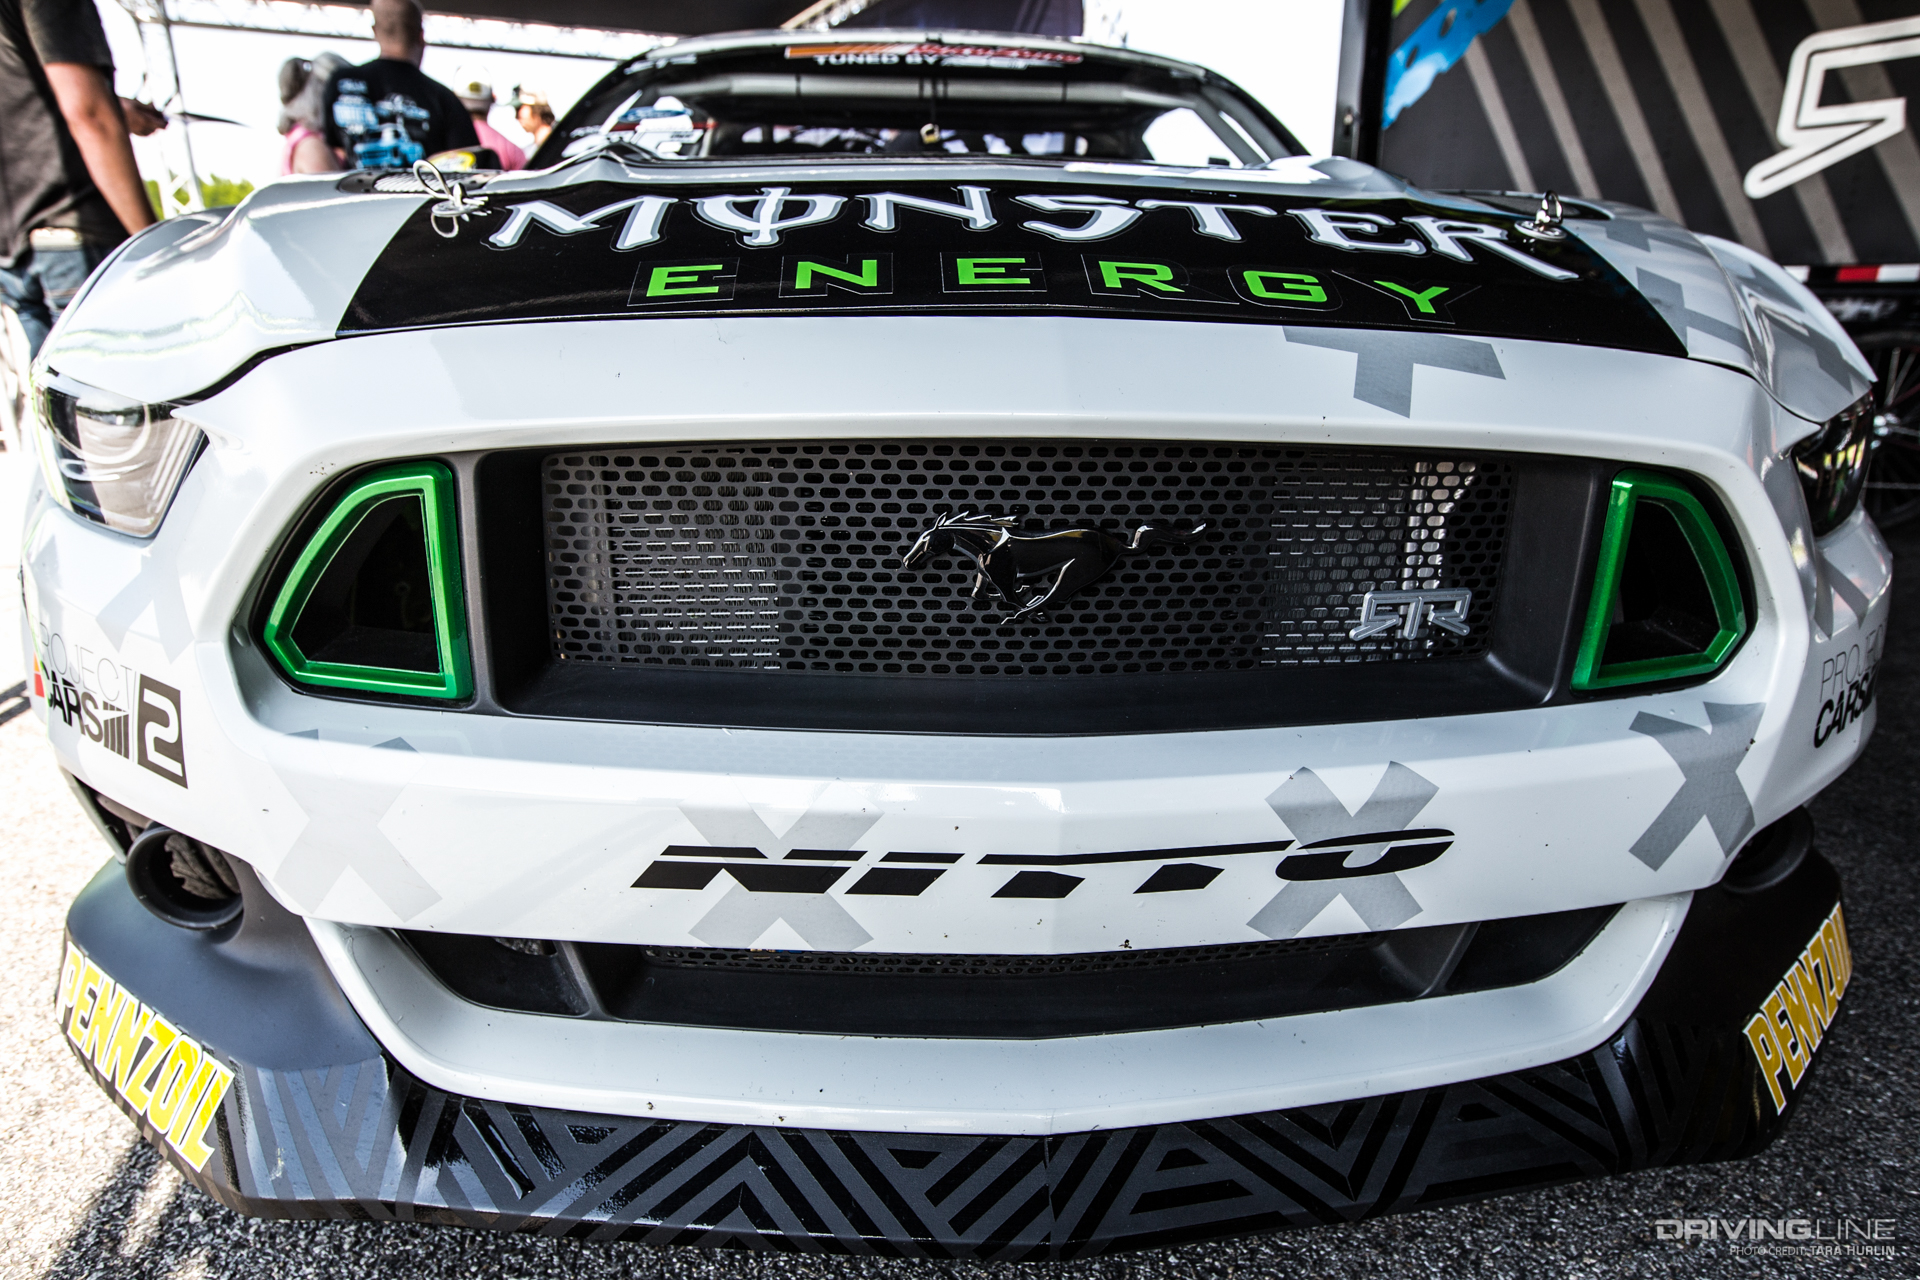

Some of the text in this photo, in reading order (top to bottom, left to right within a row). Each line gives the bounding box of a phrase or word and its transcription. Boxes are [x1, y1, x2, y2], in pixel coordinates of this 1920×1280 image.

[813, 53, 900, 66] TUNED
[905, 53, 943, 67] BY
[487, 185, 1580, 282] MONSTER
[645, 256, 1451, 315] ENERGY
[141, 683, 186, 780] 2
[1813, 671, 1870, 749] CARS
[55, 940, 236, 1174] PENNZOIL
